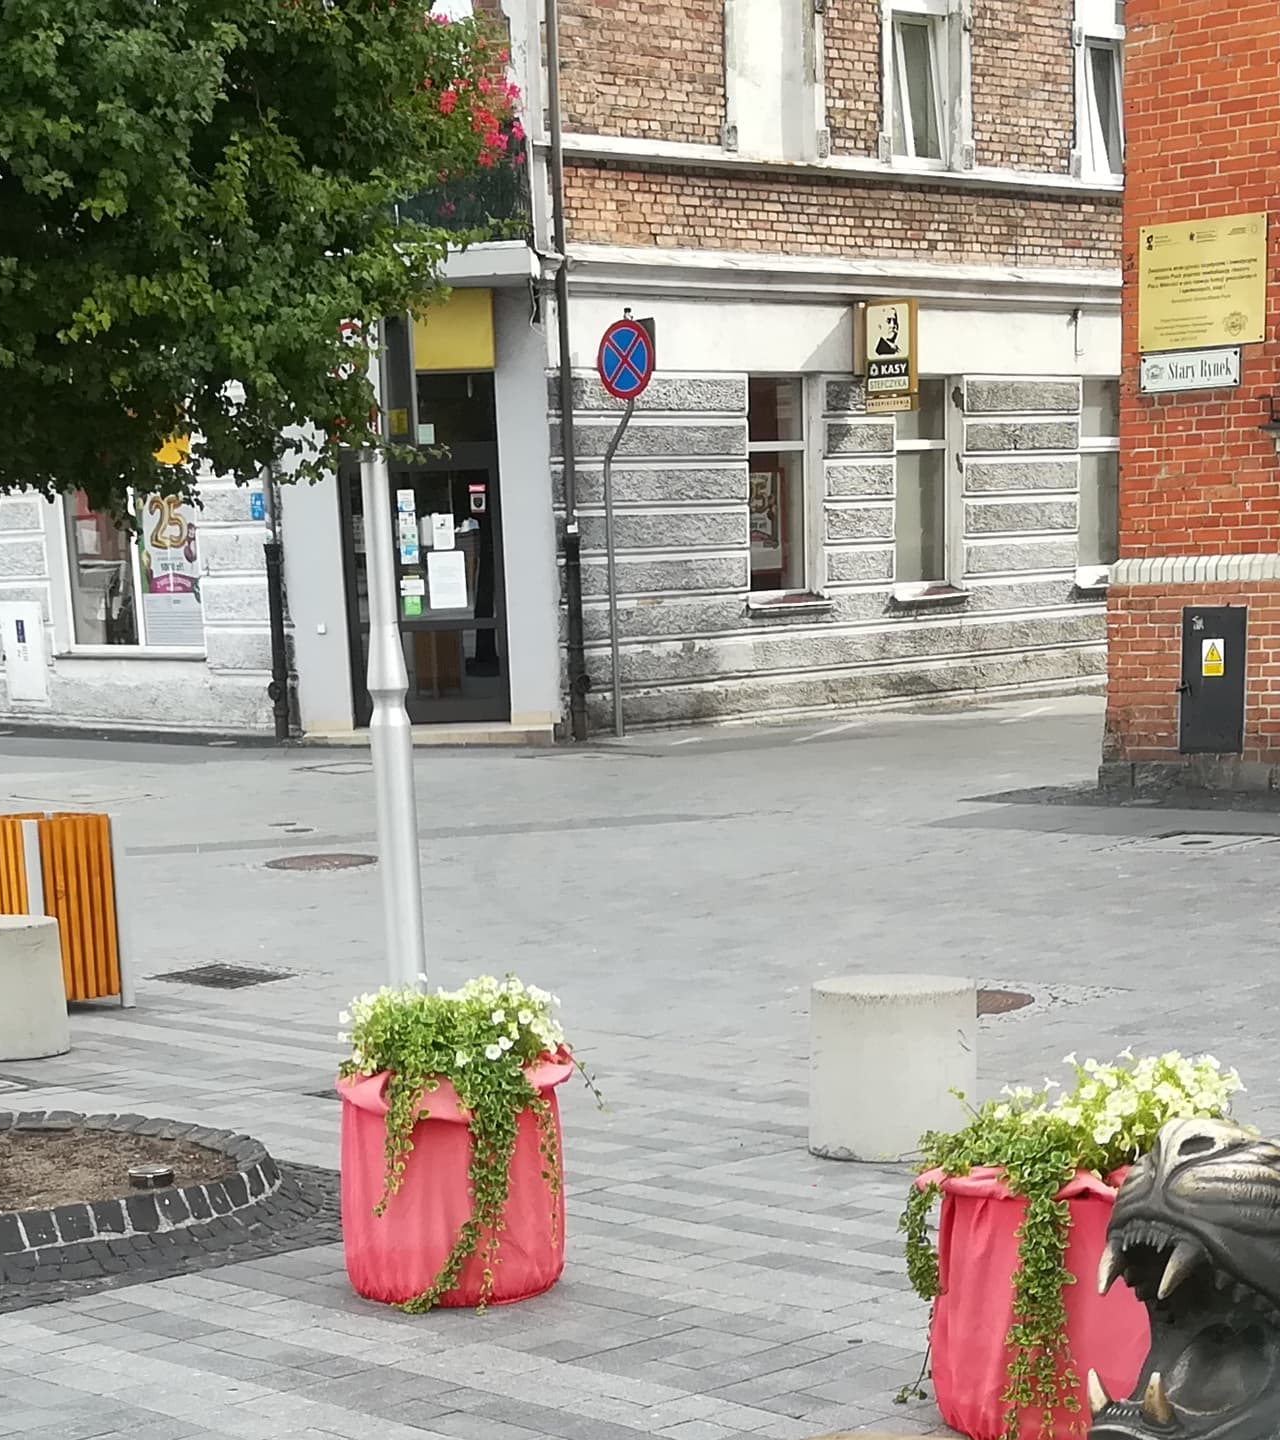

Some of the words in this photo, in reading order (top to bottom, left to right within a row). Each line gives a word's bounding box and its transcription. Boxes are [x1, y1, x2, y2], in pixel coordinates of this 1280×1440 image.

[881, 363, 907, 375] KASY
[1168, 362, 1196, 383] Stary
[1200, 357, 1232, 381] Rynek
[149, 495, 188, 549] 25
